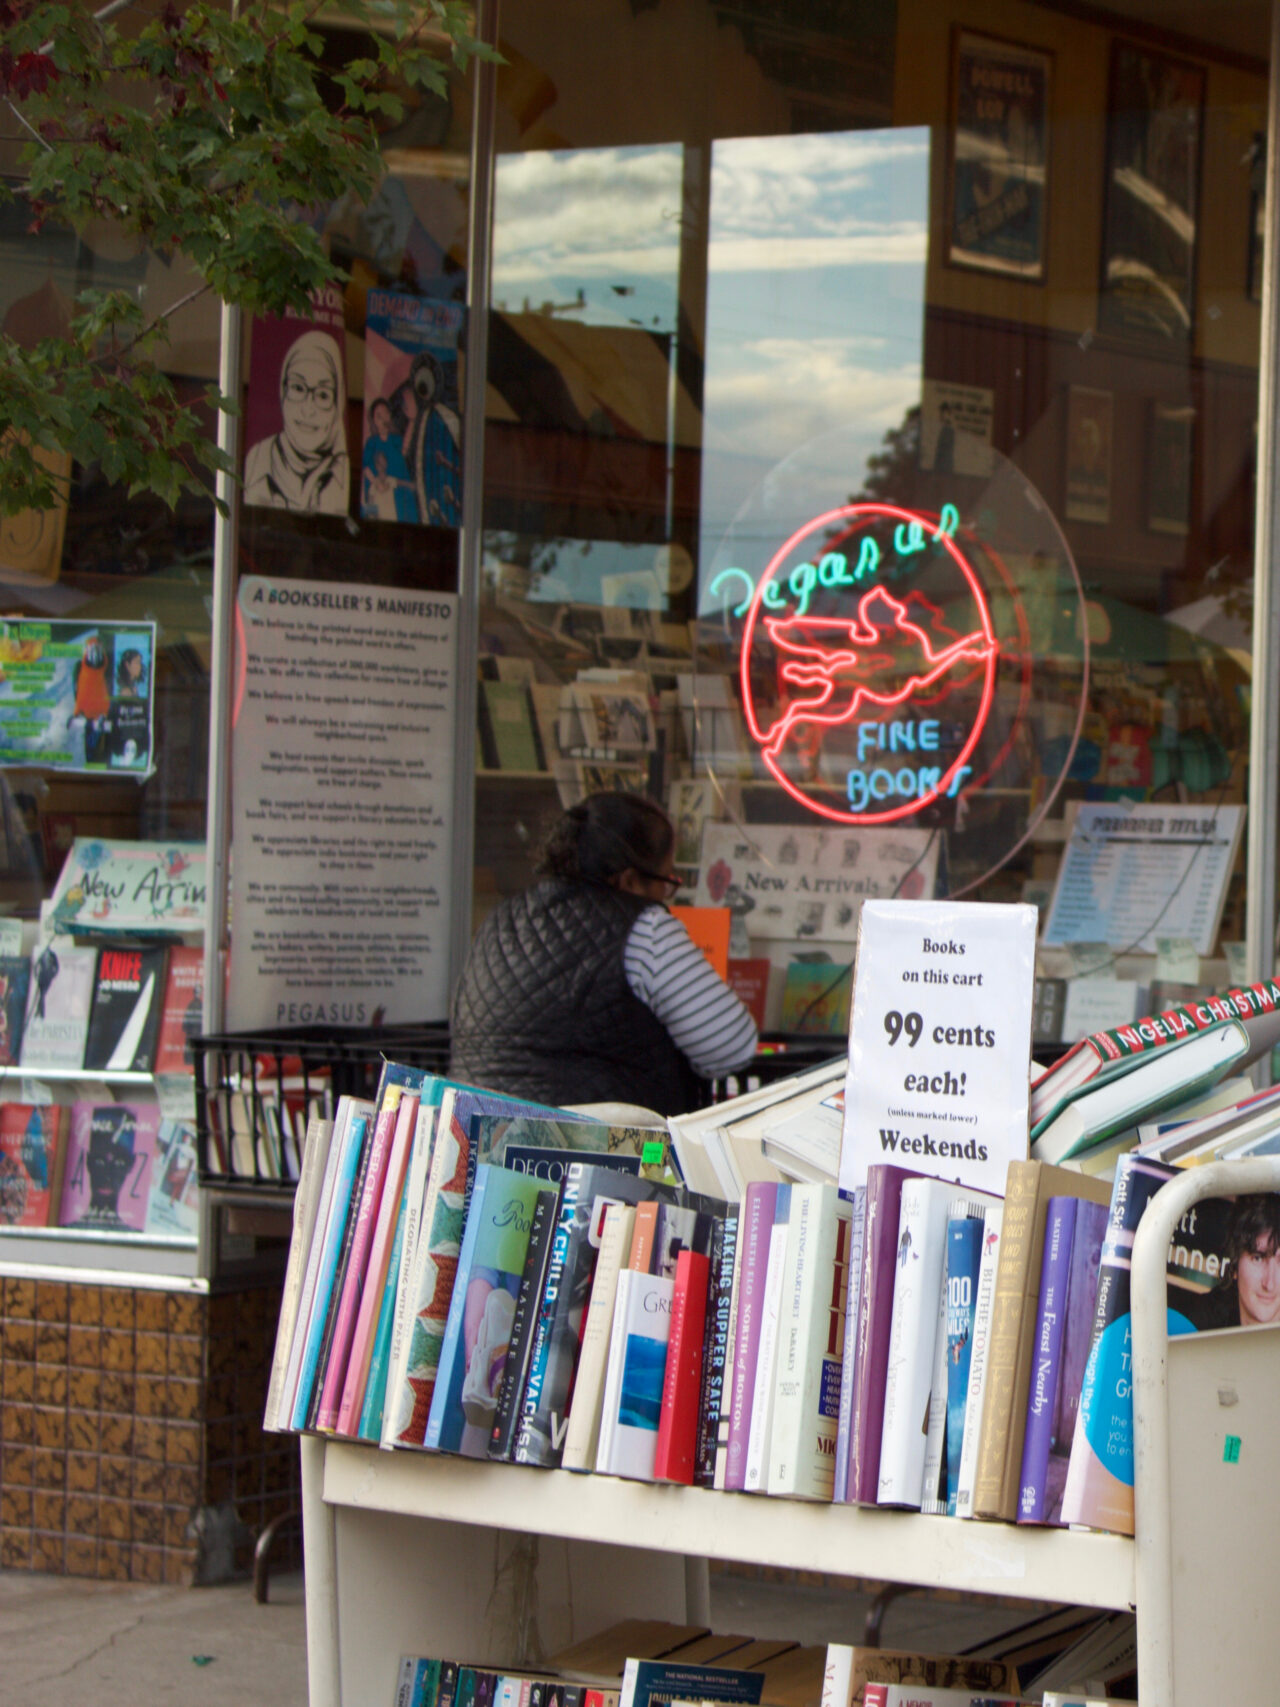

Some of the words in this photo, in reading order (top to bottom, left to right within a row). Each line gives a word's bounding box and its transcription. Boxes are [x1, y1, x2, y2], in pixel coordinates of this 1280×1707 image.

[369, 292, 420, 320] DEMAND
[253, 588, 264, 603] A
[268, 589, 373, 612] BOOKSELLER'S
[377, 599, 452, 620] MANIFESTO
[857, 720, 940, 762] FINE
[848, 766, 972, 811] BOOKS
[81, 872, 125, 898] New
[133, 867, 206, 902] Arriv
[745, 873, 788, 892] New
[795, 875, 880, 895] Arrivals
[100, 951, 142, 981] KNIFE
[923, 938, 966, 955] Books
[902, 970, 919, 983] on
[923, 969, 949, 985] this
[953, 972, 983, 986] cart
[277, 1003, 366, 1022] PEGASUS
[884, 1011, 924, 1048] 99
[932, 1024, 996, 1048] cents
[1117, 1013, 1195, 1048] NIGELLA
[904, 1071, 967, 1097] each!
[887, 1107, 915, 1119] (unless
[916, 1110, 948, 1122] marked
[949, 1113, 978, 1125] lower)
[879, 1129, 988, 1162] Weekends
[560, 1162, 583, 1235] ONLY
[1115, 1168, 1131, 1203] Matt
[531, 1204, 545, 1246] MAN
[1051, 1217, 1062, 1261] MATHER
[401, 1208, 417, 1286] DECORATING
[720, 1217, 738, 1289] MAKING
[546, 1236, 567, 1301] CHILD
[792, 1295, 800, 1318] DIET
[948, 1277, 971, 1306] 100
[1097, 1276, 1111, 1317] Heard
[509, 1280, 530, 1359] NATURE
[712, 1296, 730, 1367] SUPPER
[740, 1303, 752, 1354] NORTH
[1040, 1311, 1057, 1352] Feast
[393, 1322, 403, 1361] PAPER
[1086, 1330, 1104, 1385] Through
[969, 1330, 987, 1396] TOMATO
[708, 1376, 722, 1421] SAFE
[733, 1374, 745, 1432] BOSTON
[1031, 1358, 1052, 1416] Nearby
[1081, 1387, 1094, 1411] the
[516, 1374, 542, 1462] VACHSS
[1108, 1430, 1127, 1443] you
[1111, 1415, 1128, 1427] the
